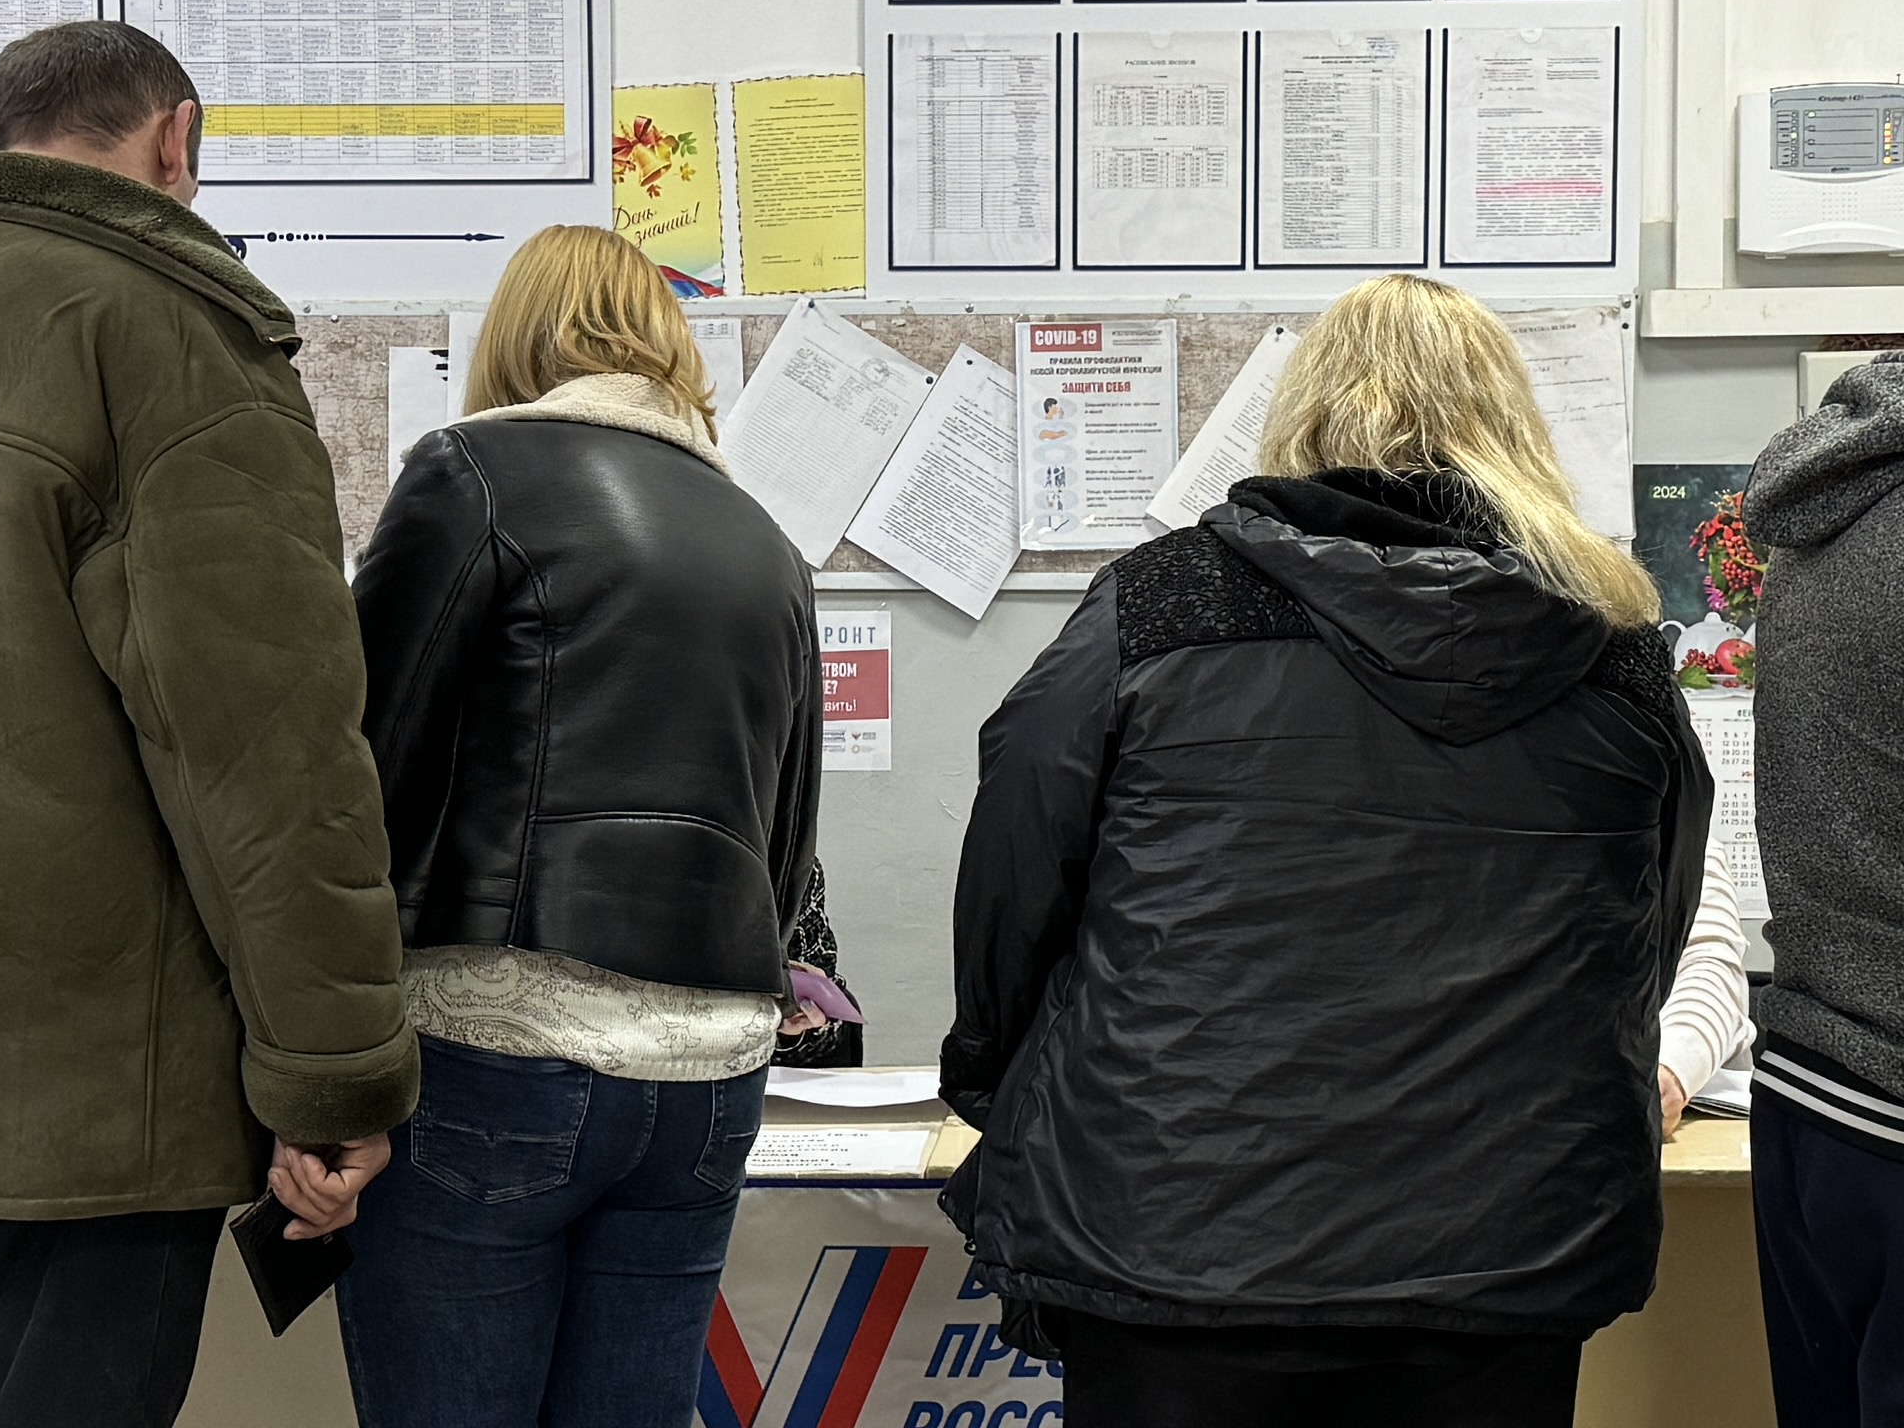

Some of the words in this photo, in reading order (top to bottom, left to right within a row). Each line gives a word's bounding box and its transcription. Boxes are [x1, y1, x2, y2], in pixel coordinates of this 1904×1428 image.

[634, 201, 700, 249] знаний!
[1034, 329, 1097, 346] COVID-19
[1061, 381, 1104, 394] ЗАЩИТИ
[1105, 381, 1131, 393] СЕБЯ
[1652, 485, 1686, 499] 2024
